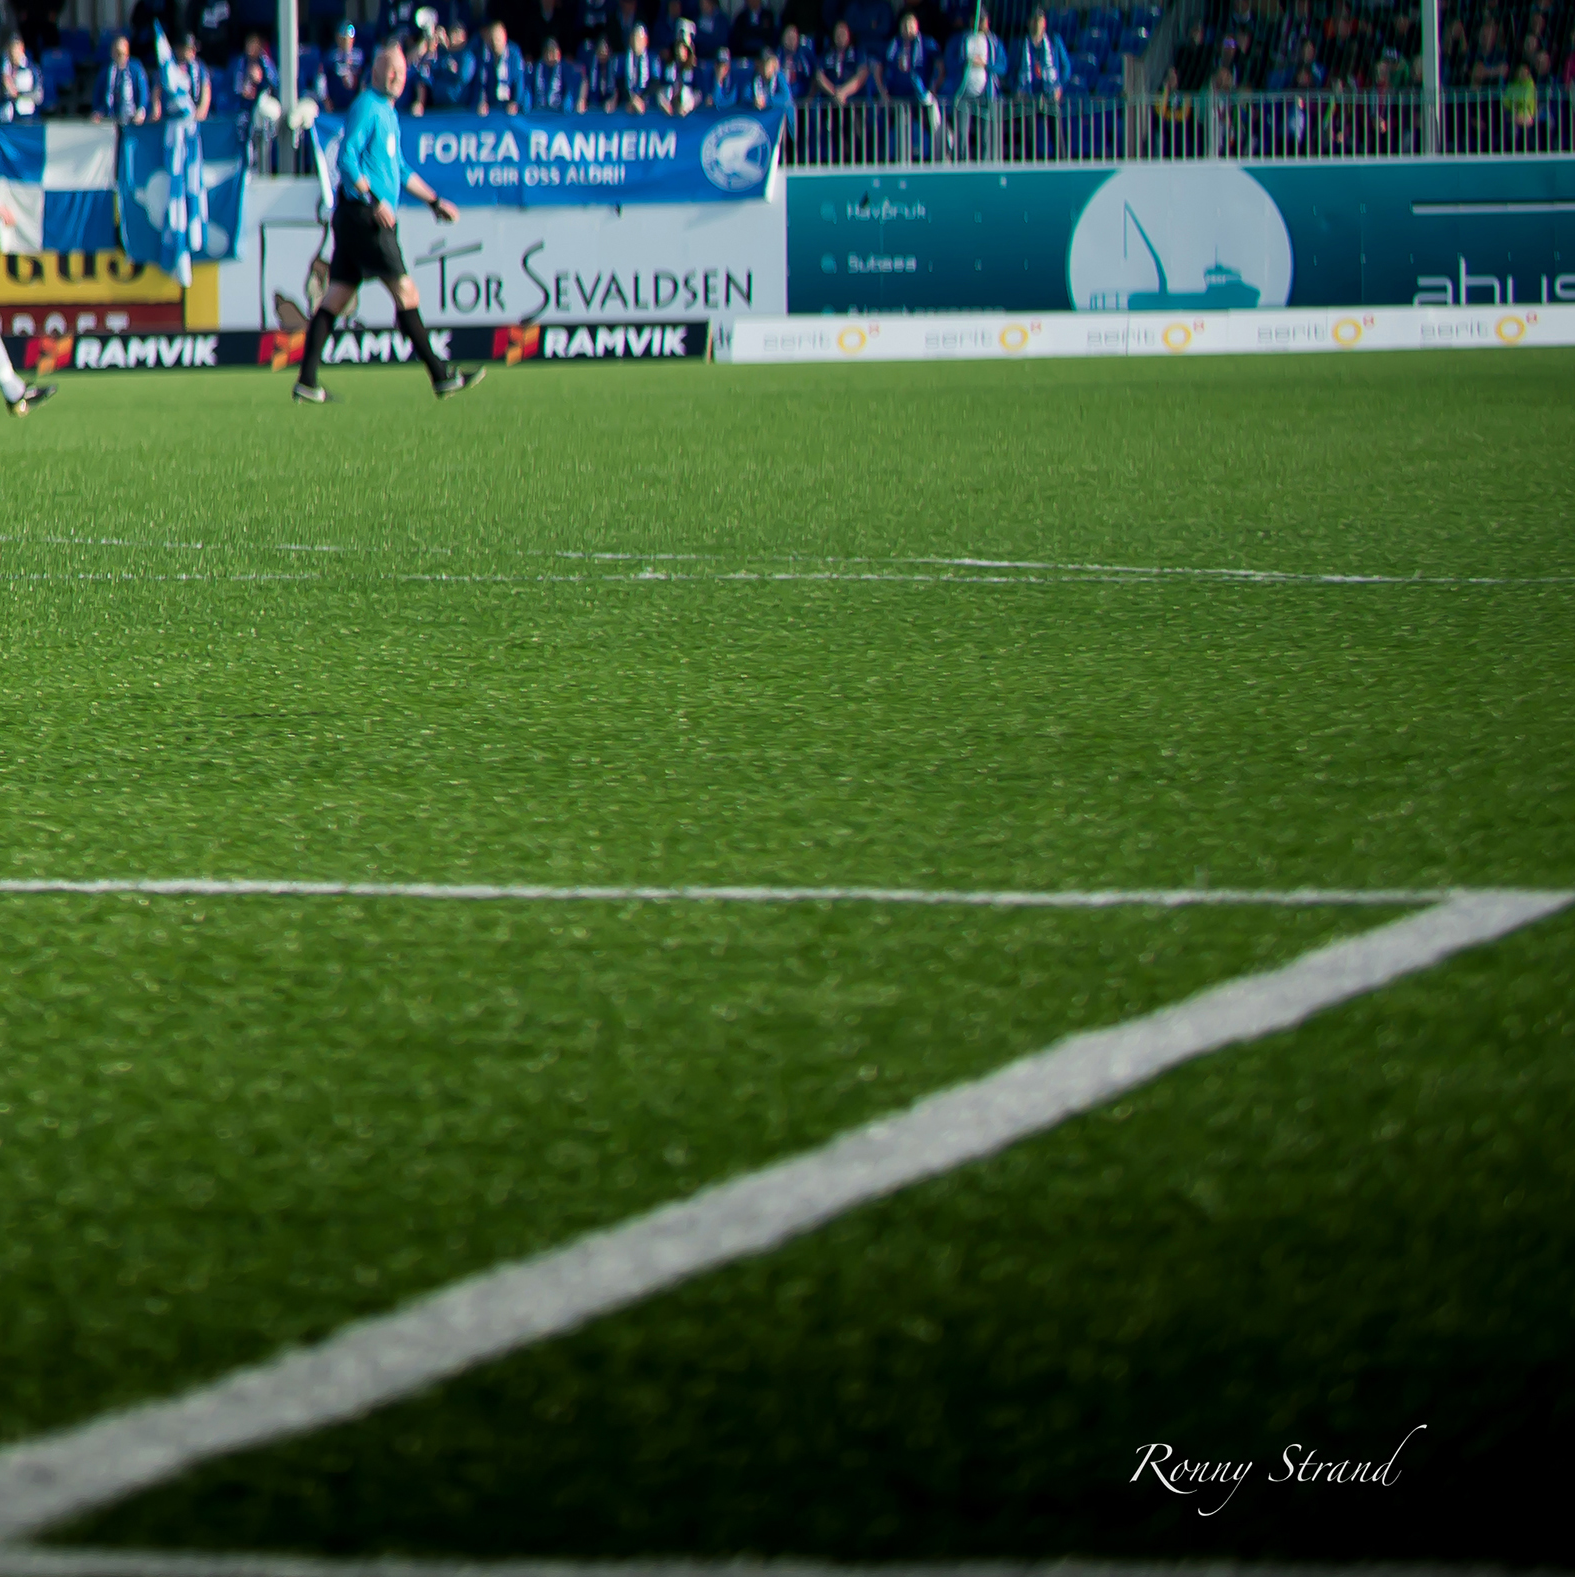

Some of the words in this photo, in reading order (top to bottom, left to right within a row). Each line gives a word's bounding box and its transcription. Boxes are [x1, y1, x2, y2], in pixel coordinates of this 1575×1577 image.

[418, 129, 520, 165] FORZA
[529, 127, 678, 162] RANHEIM
[466, 166, 485, 188] VI
[489, 165, 520, 187] GIR
[524, 163, 560, 187] OSS
[75, 334, 218, 369] RAMVIK
[321, 329, 452, 364] AMVK
[544, 326, 686, 358] RAMVIK
